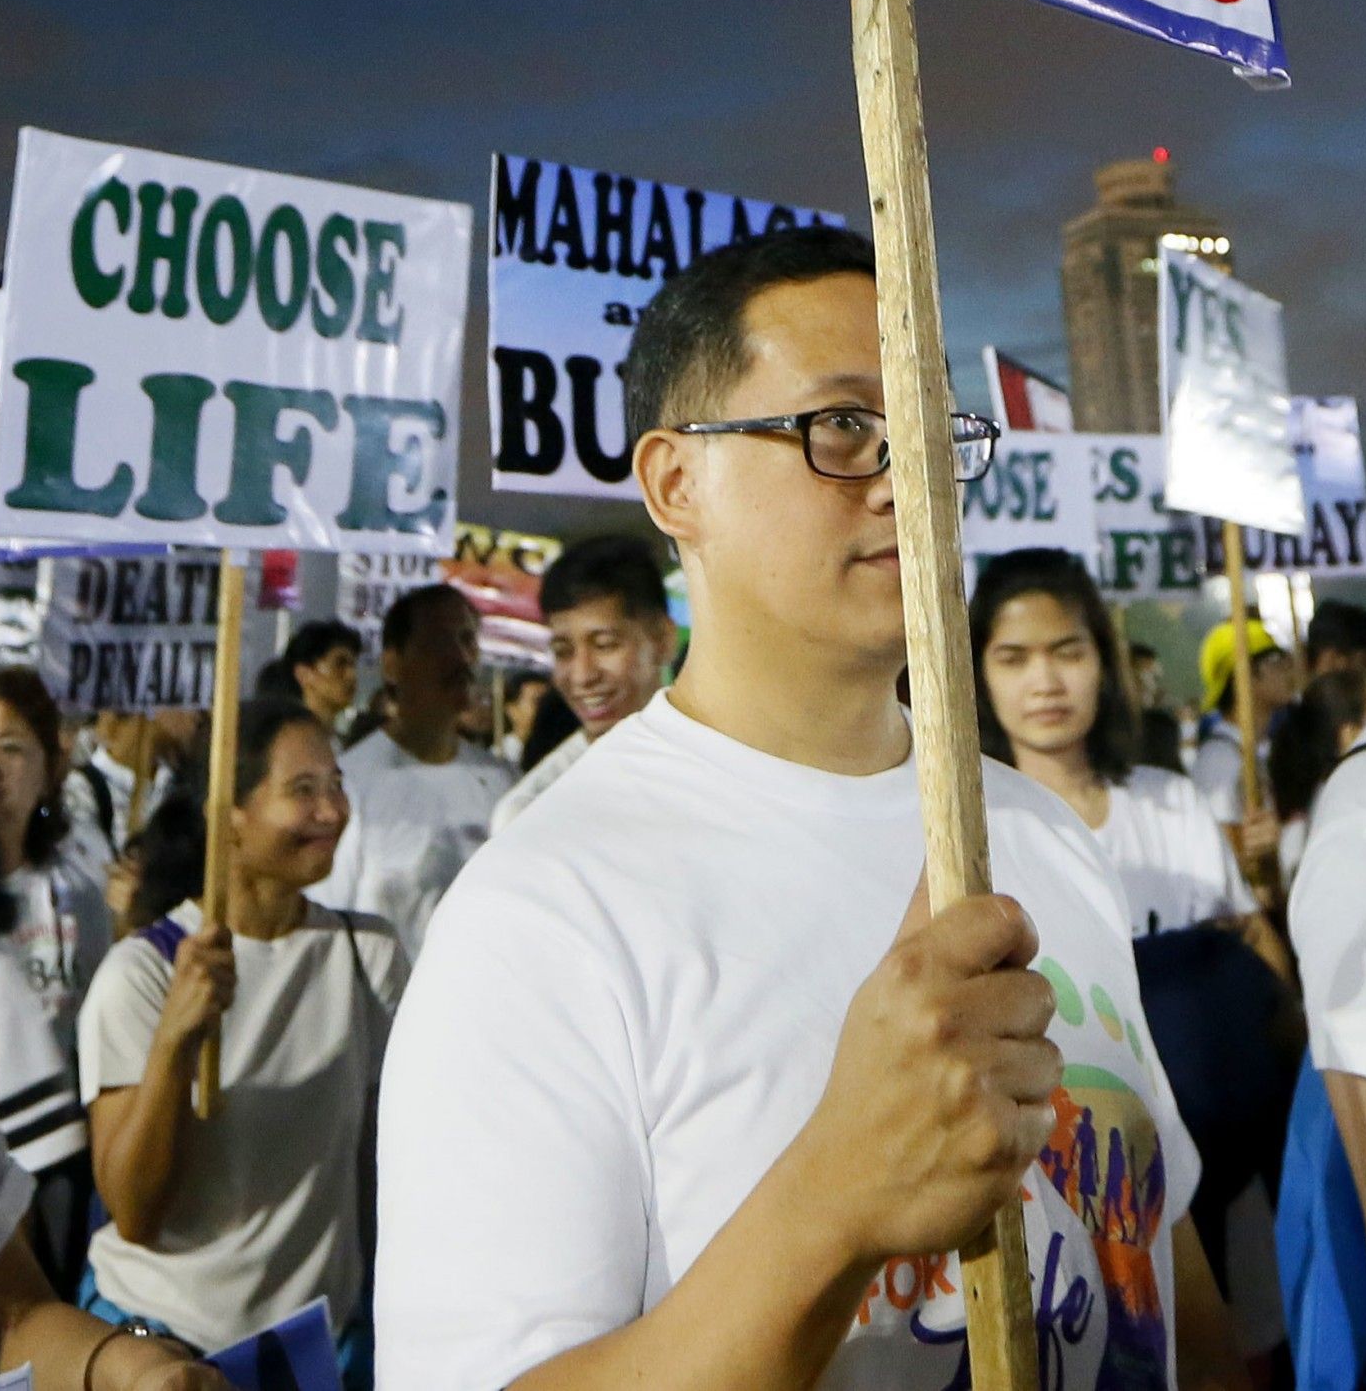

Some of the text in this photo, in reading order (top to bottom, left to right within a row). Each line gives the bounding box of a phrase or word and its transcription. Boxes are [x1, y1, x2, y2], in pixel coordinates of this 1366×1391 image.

[70, 175, 407, 345] CHOOSE
[495, 153, 823, 280] MAHAL
[4, 356, 448, 535] LIFE
[76, 557, 220, 626] DEAT
[68, 641, 218, 708] PENALT
